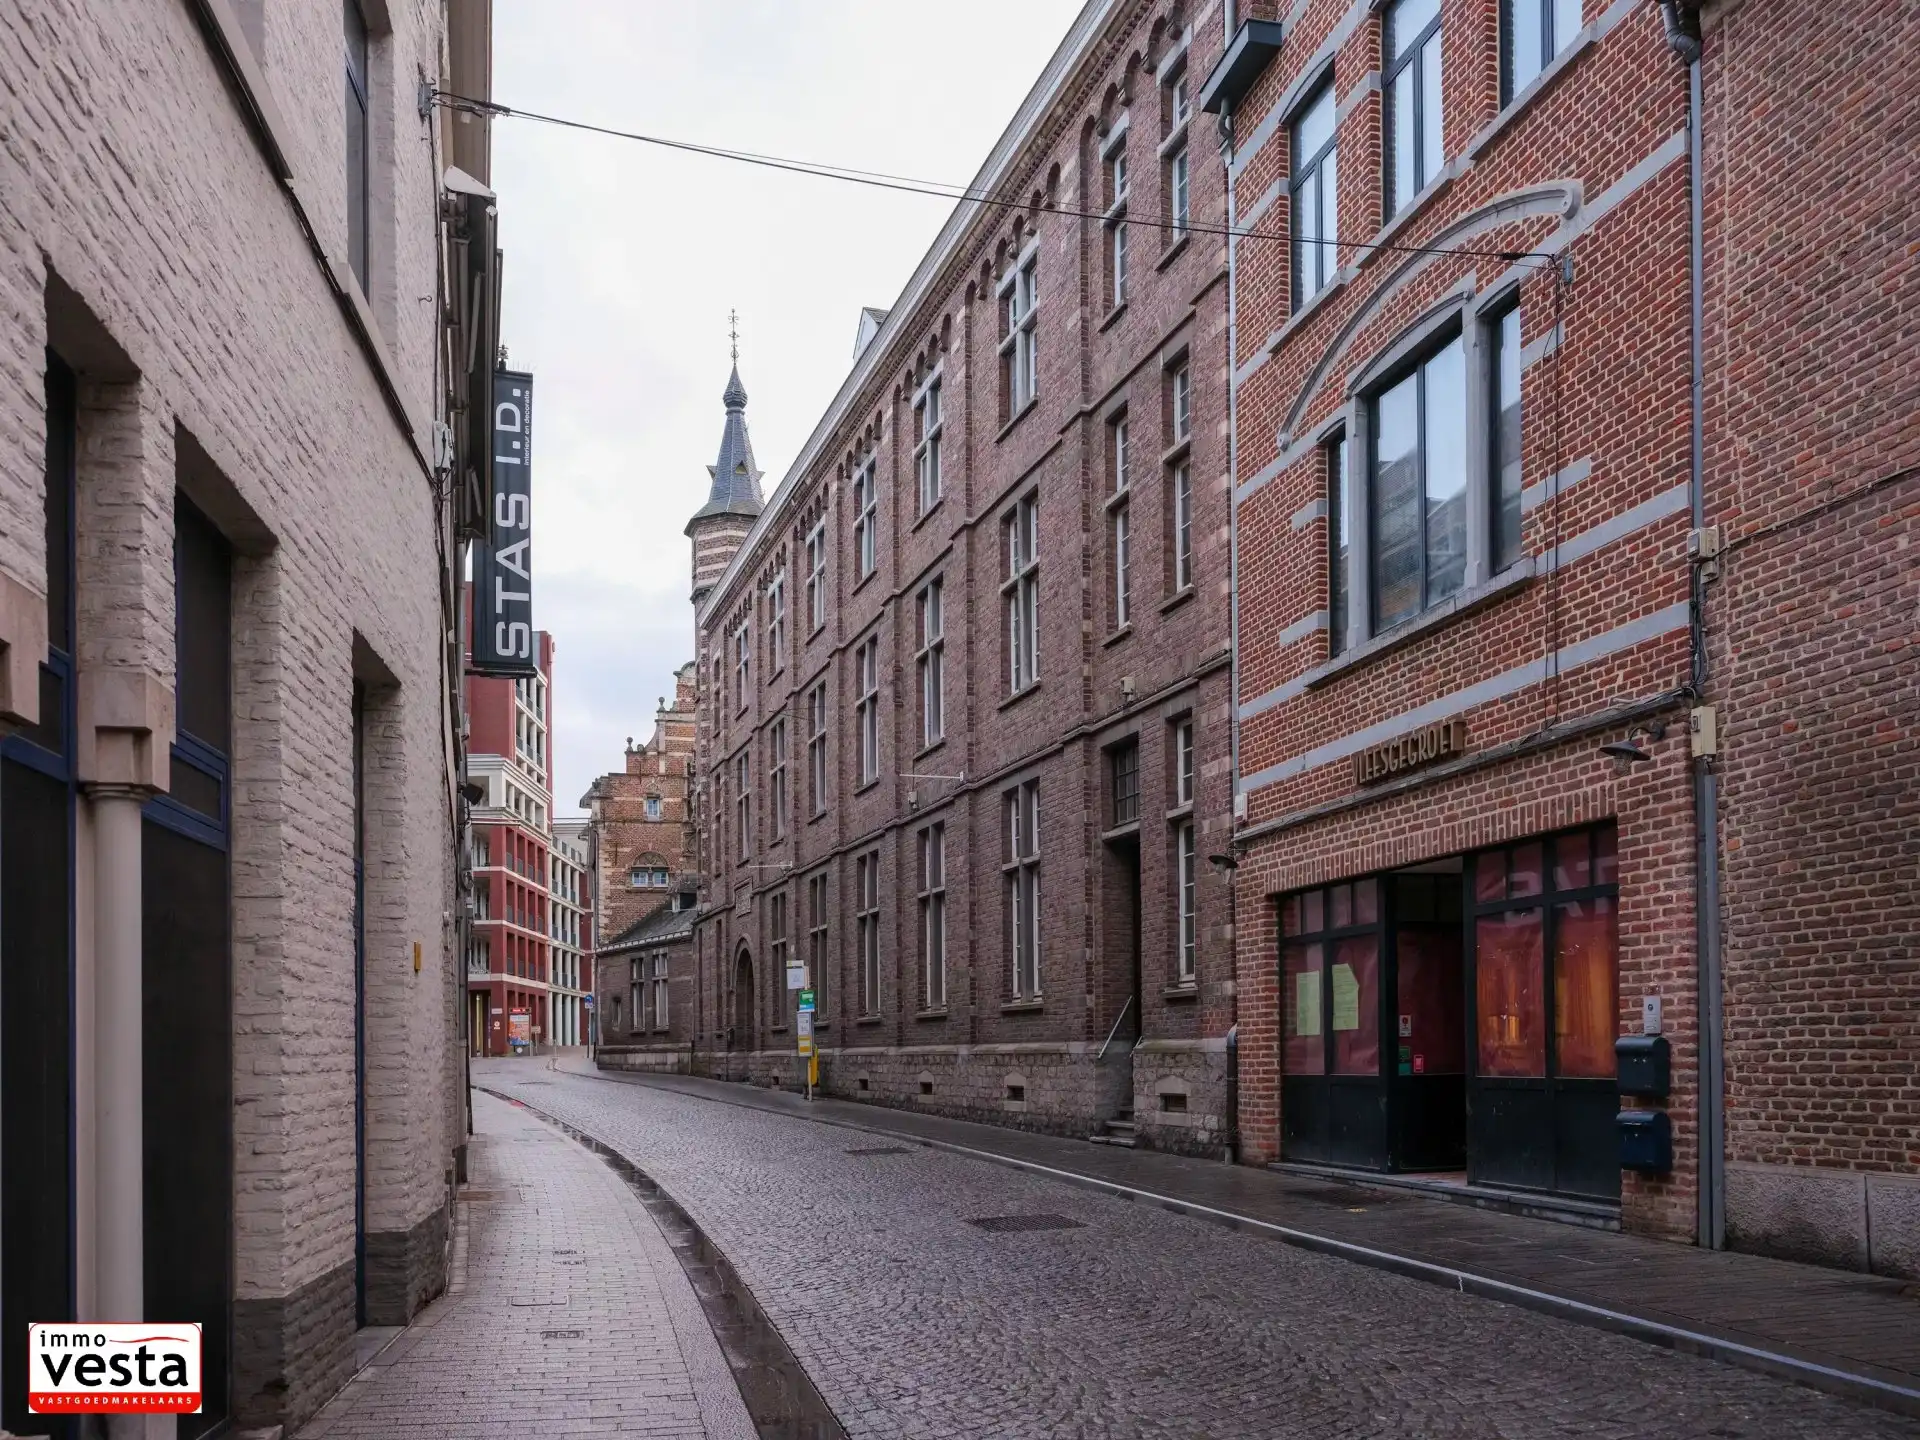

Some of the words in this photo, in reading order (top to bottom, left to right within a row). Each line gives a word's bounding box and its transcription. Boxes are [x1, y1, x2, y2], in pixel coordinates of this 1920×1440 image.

[495, 387, 521, 465] I.D.
[523, 390, 531, 424] decoratie
[524, 425, 530, 435] en
[495, 492, 530, 659] STAS
